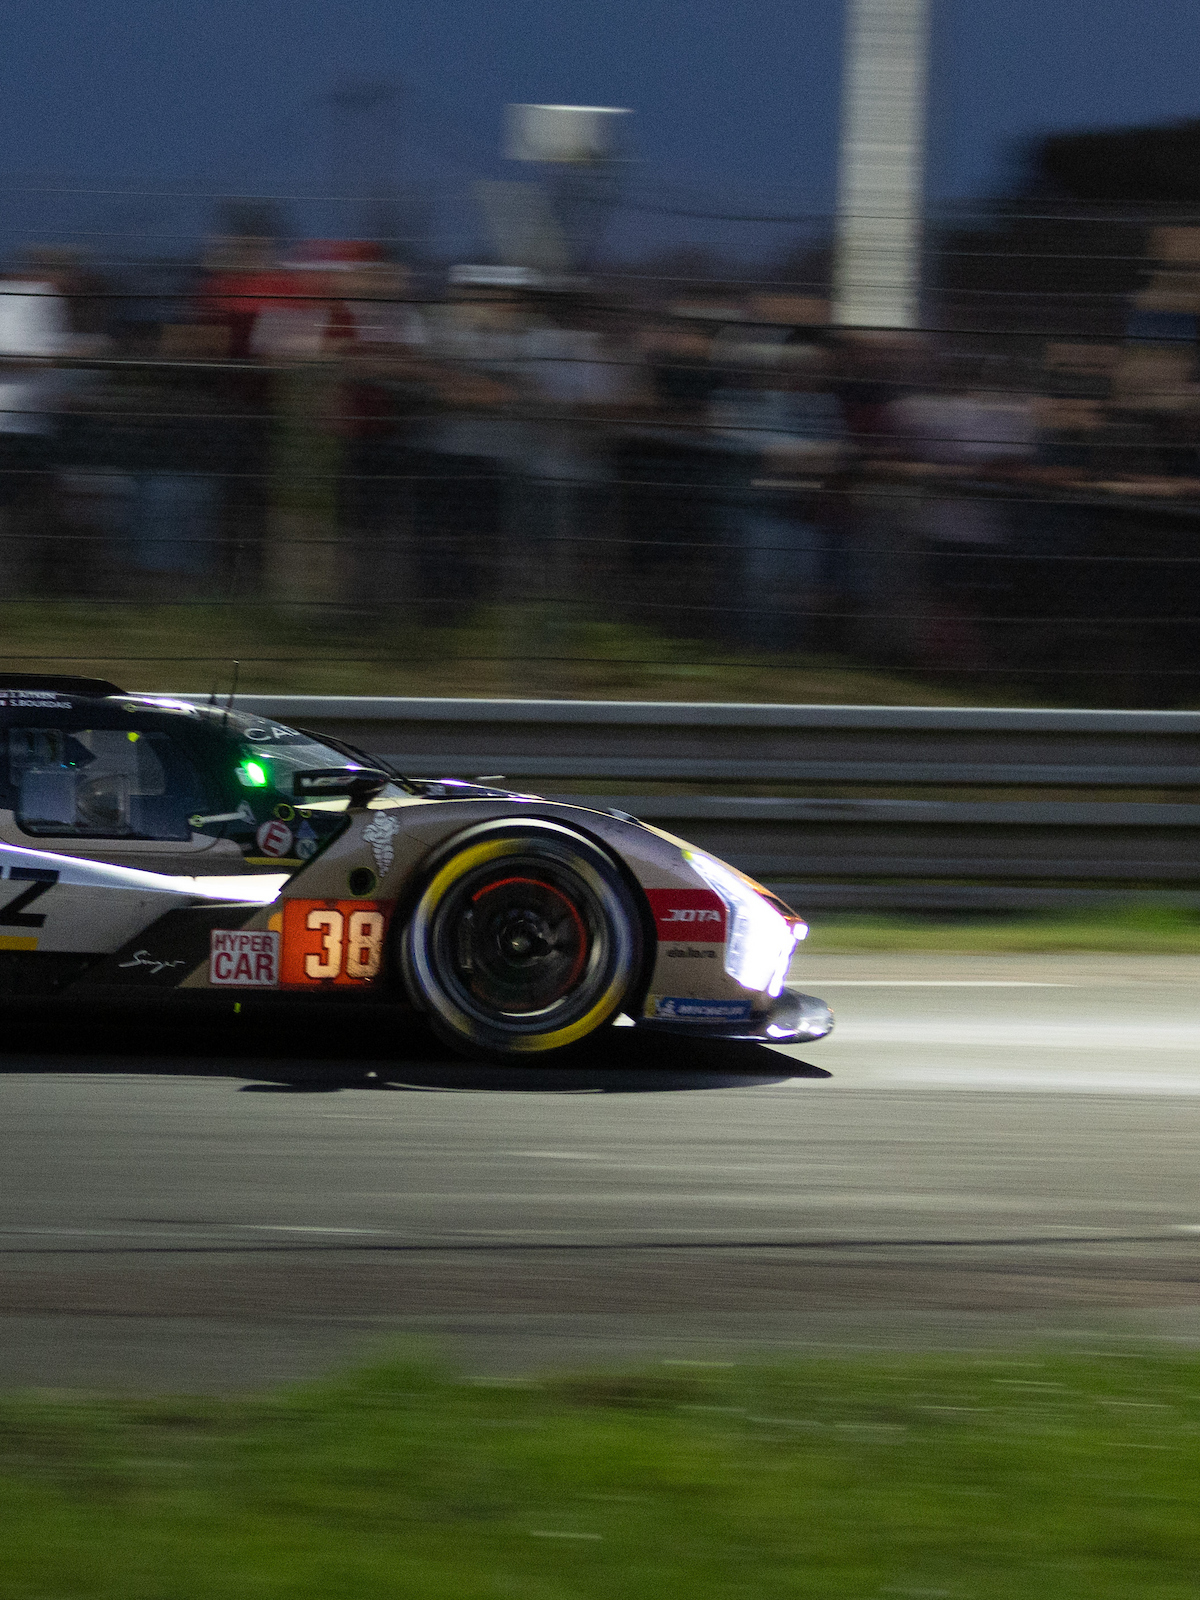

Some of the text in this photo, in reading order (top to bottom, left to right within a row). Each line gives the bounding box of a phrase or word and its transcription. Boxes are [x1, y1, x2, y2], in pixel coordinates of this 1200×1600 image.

[263, 819, 287, 855] E
[660, 908, 722, 923] JOTA
[214, 934, 274, 952] HYPER
[304, 908, 385, 980] 38
[214, 951, 275, 981] CAR
